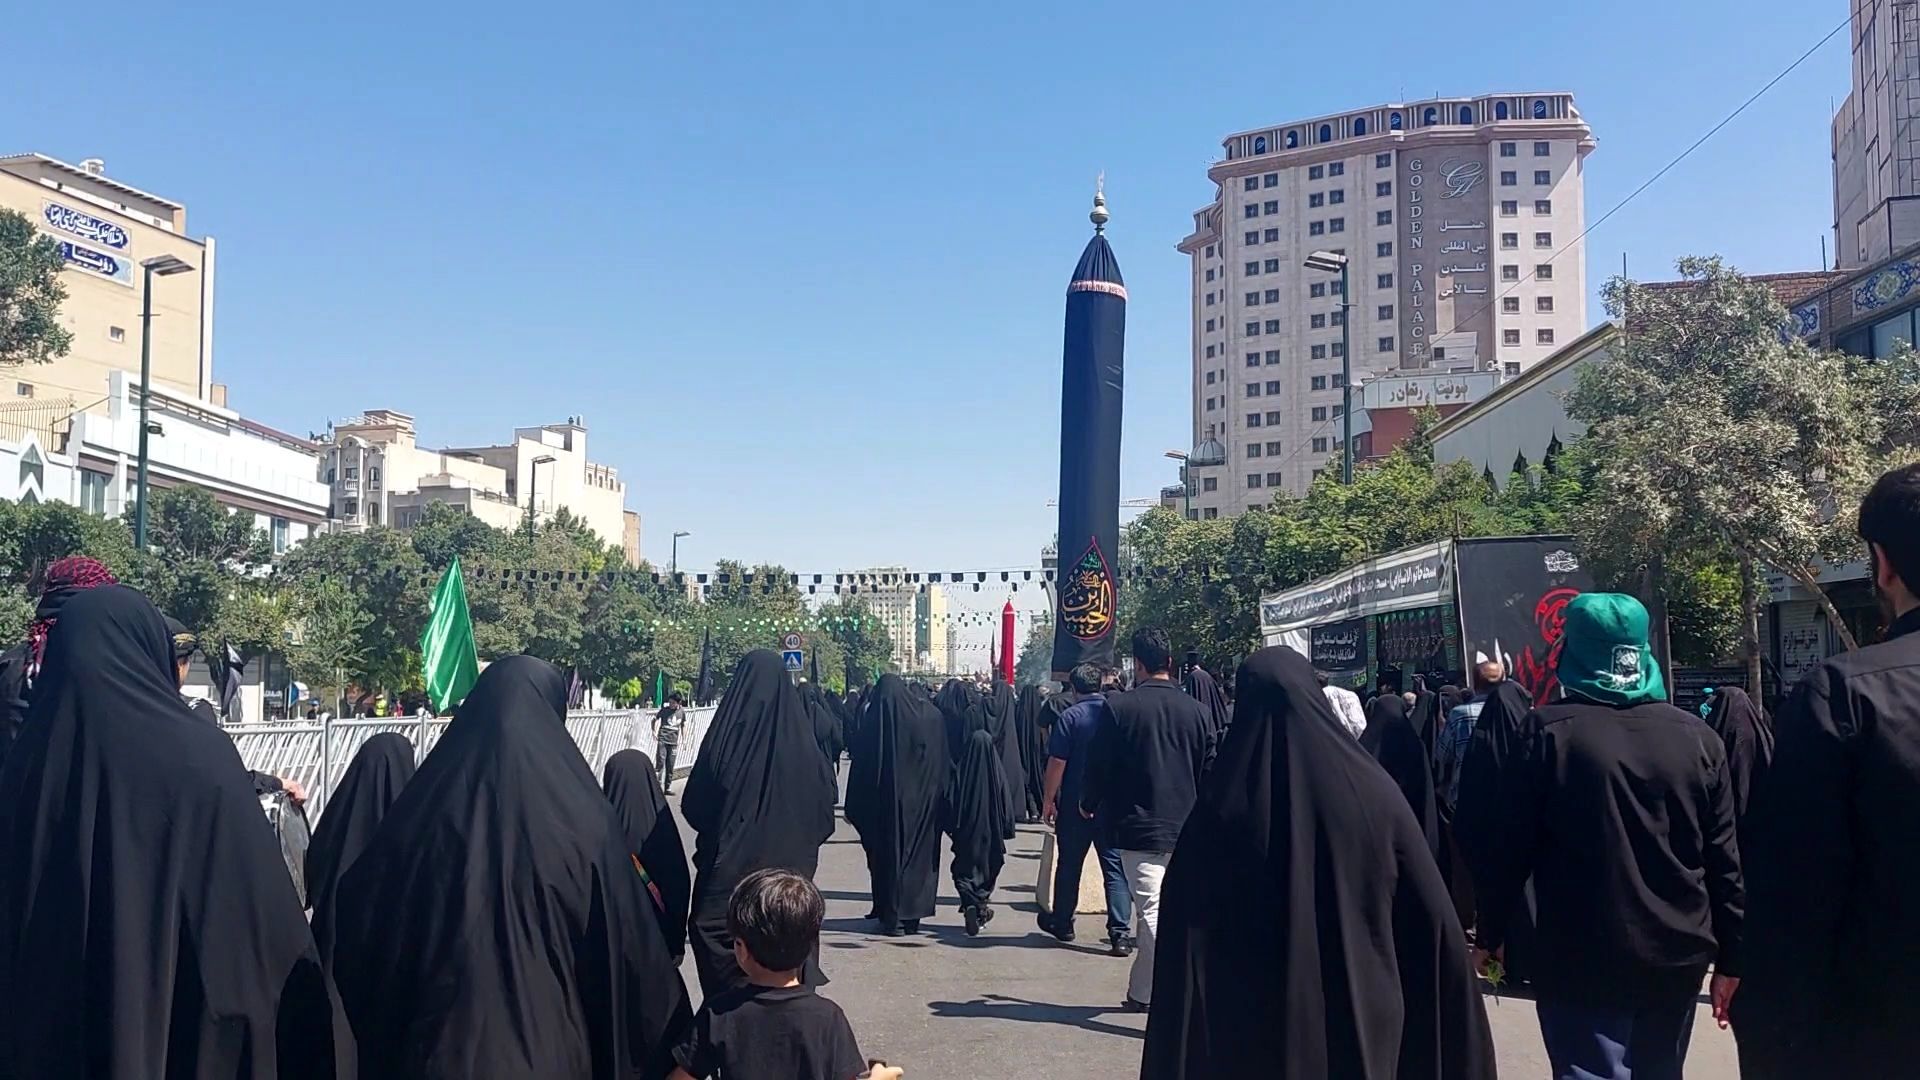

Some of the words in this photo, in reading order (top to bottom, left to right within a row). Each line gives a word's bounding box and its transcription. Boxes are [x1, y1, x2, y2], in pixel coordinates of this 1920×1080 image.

[1410, 159, 1423, 249] GOLDEN
[1410, 264, 1424, 355] PALACE
[787, 636, 799, 646] 40
